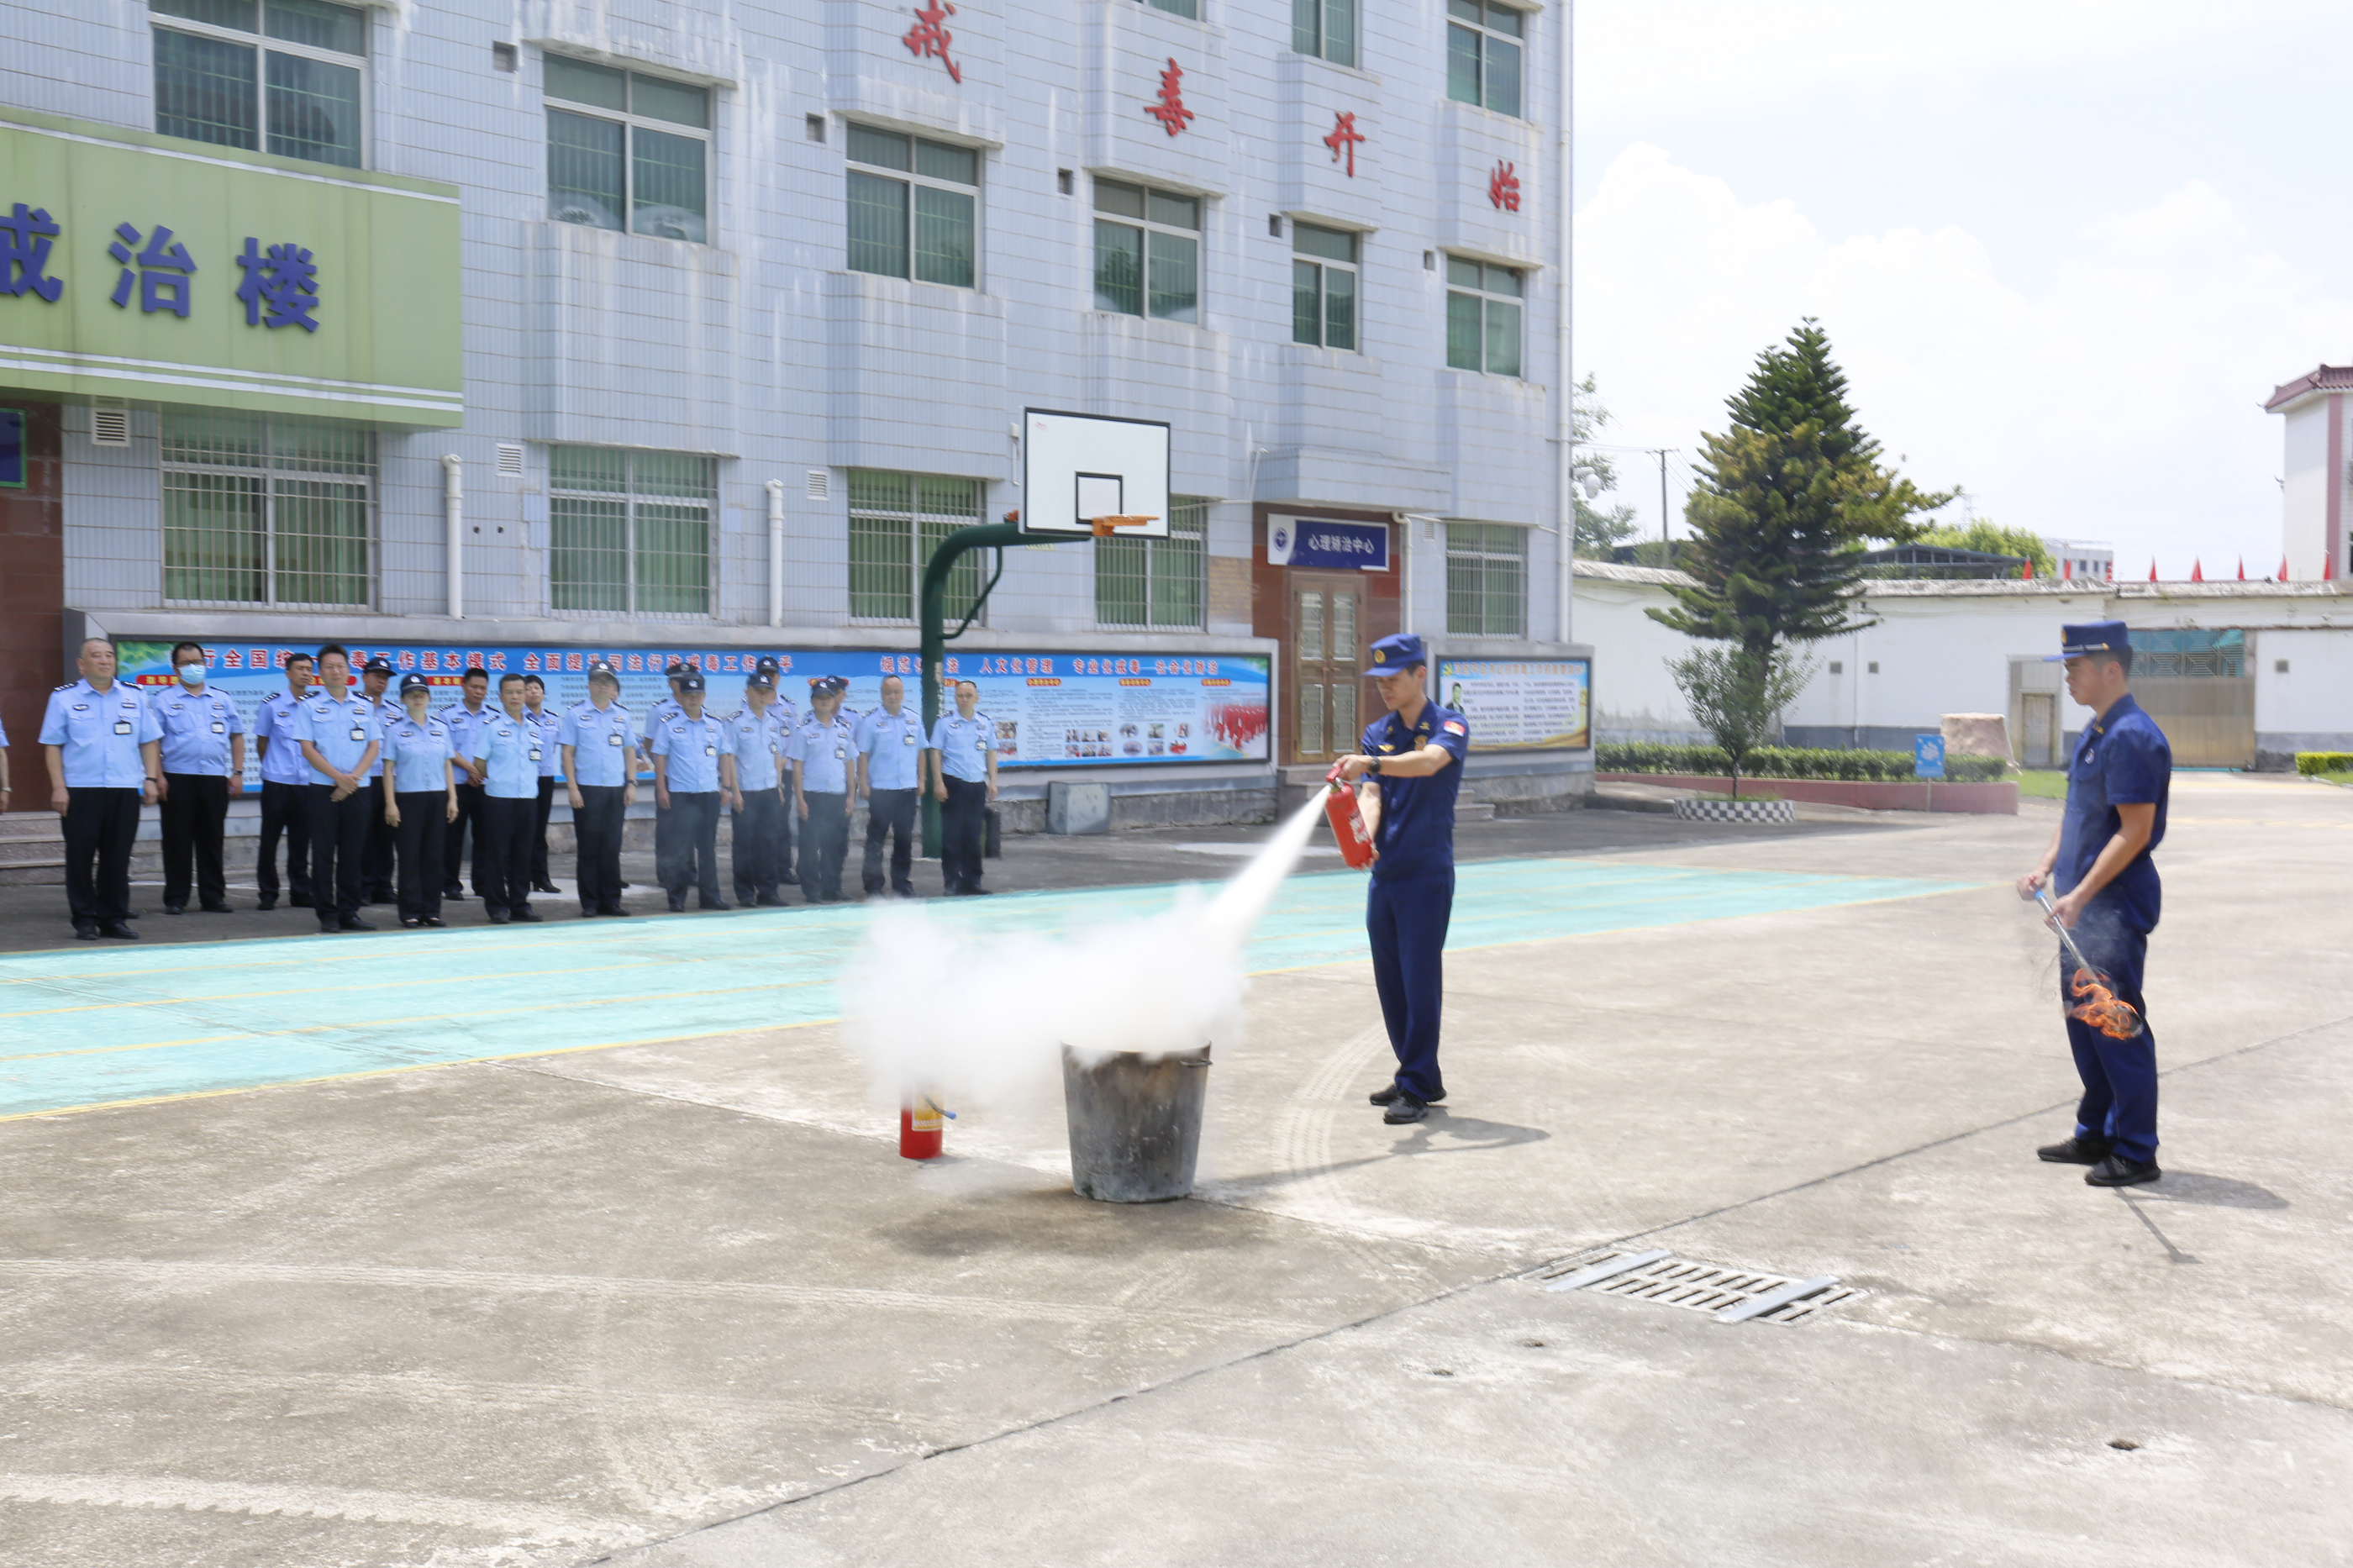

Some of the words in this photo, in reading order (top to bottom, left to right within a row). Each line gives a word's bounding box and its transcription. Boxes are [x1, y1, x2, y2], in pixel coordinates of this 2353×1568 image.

[1308, 533, 1376, 555] 心理矫治中心
